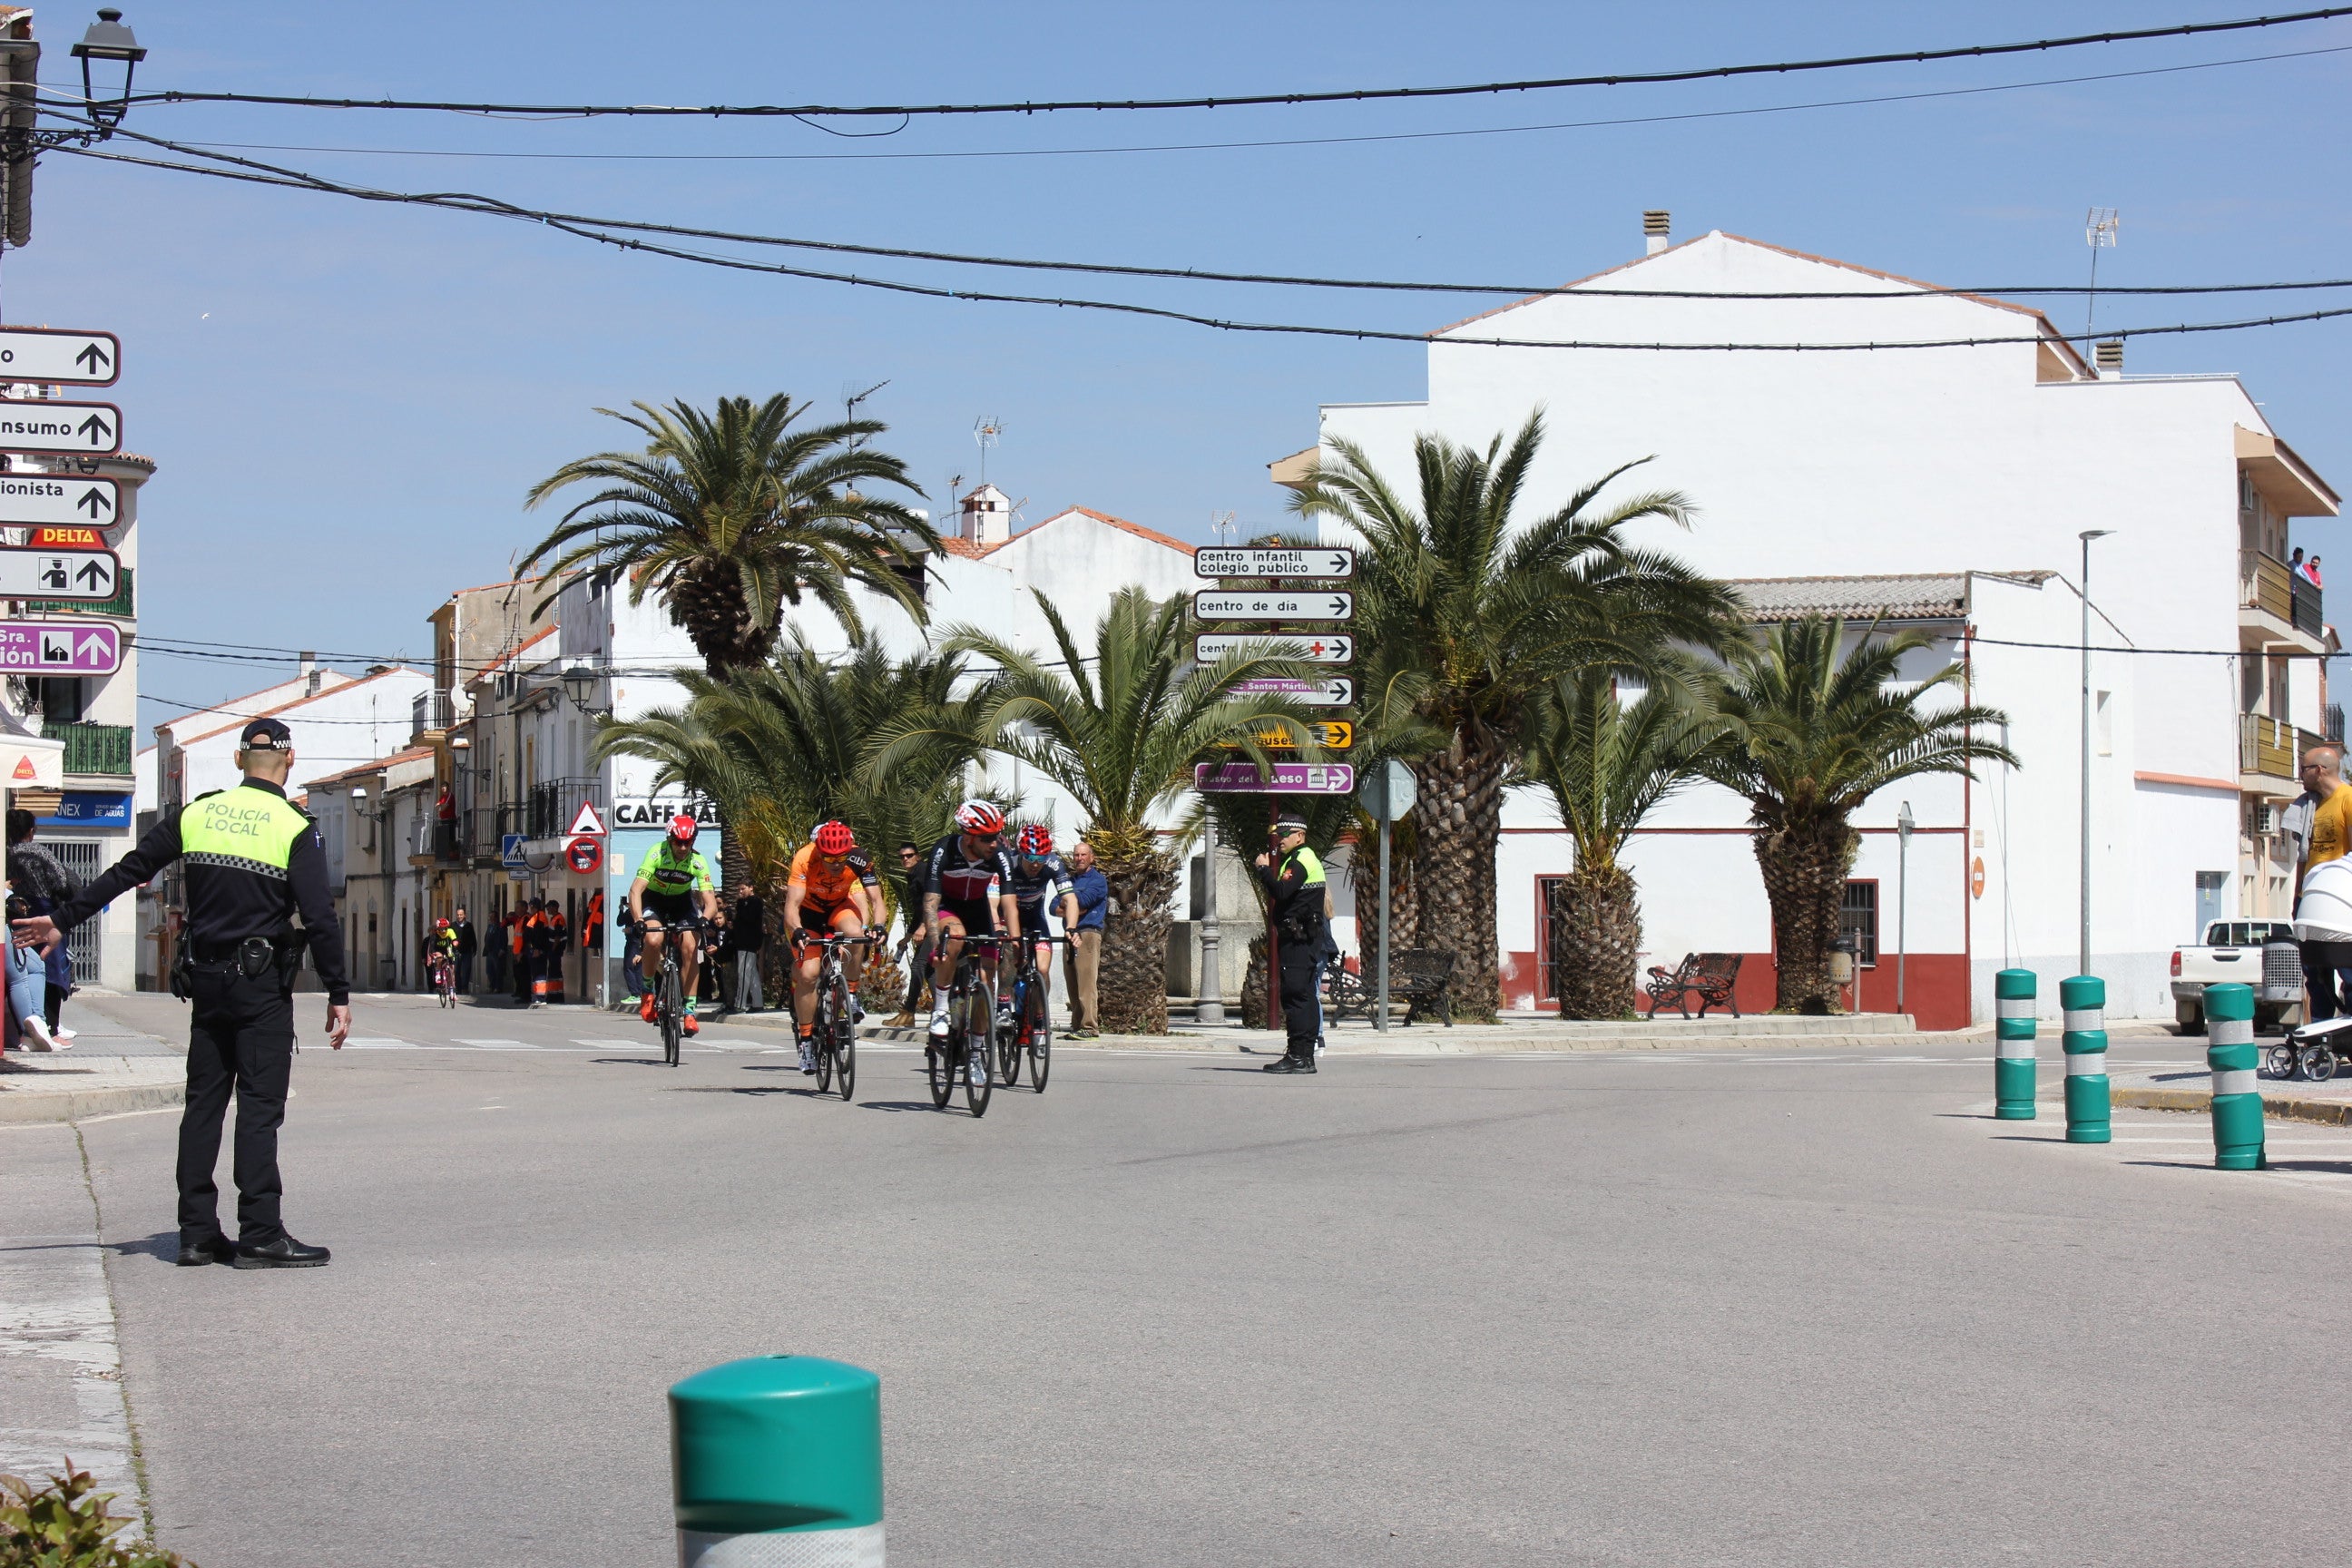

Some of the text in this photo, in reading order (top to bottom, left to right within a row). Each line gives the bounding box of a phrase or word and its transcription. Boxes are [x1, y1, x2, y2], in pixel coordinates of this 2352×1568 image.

[44, 528, 94, 543] DELTA
[1200, 551, 1303, 563] centro infantil
[1200, 561, 1308, 575] colegio público
[1200, 599, 1298, 612] centro de día
[1248, 682, 1279, 691] Santos
[1238, 775, 1254, 784] del
[94, 808, 125, 818] DE AGUAS
[615, 800, 721, 824] CAFÉ BA
[205, 817, 260, 837] LOCAL
